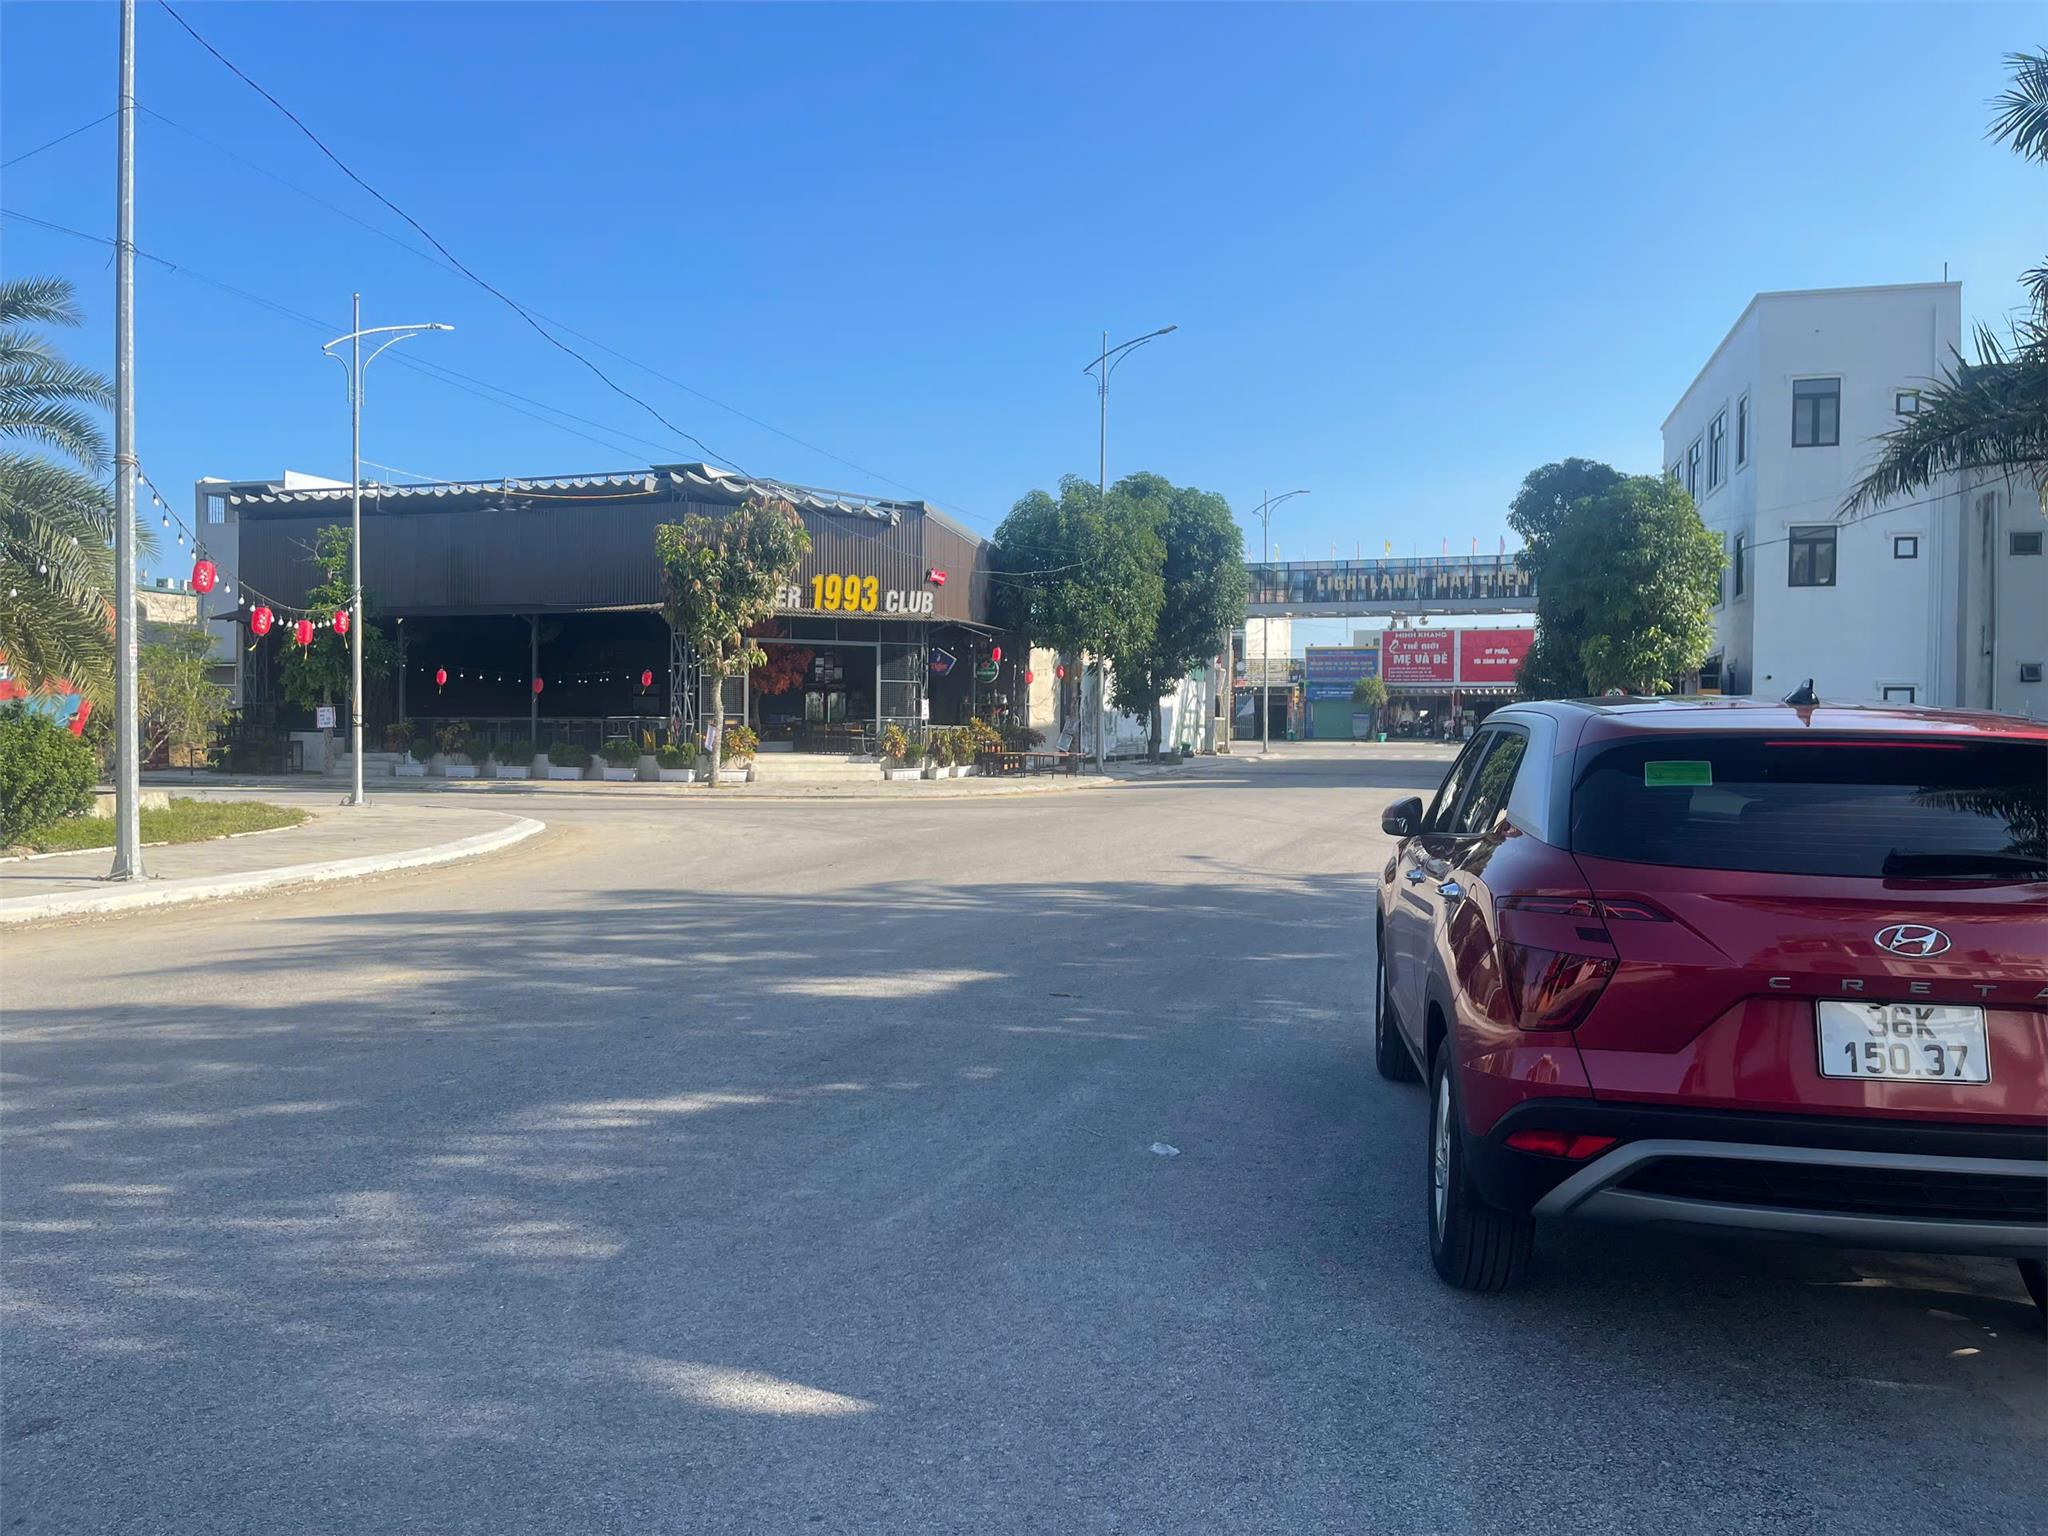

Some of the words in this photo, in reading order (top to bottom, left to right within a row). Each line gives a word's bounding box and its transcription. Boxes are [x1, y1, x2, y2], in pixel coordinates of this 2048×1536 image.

[775, 586, 802, 608] ER
[811, 573, 879, 612] 1993
[885, 590, 934, 613] CLUB
[1768, 975, 2048, 1000] CRETA
[1866, 1006, 1937, 1040] 36K
[1844, 1041, 1969, 1078] 150.37
